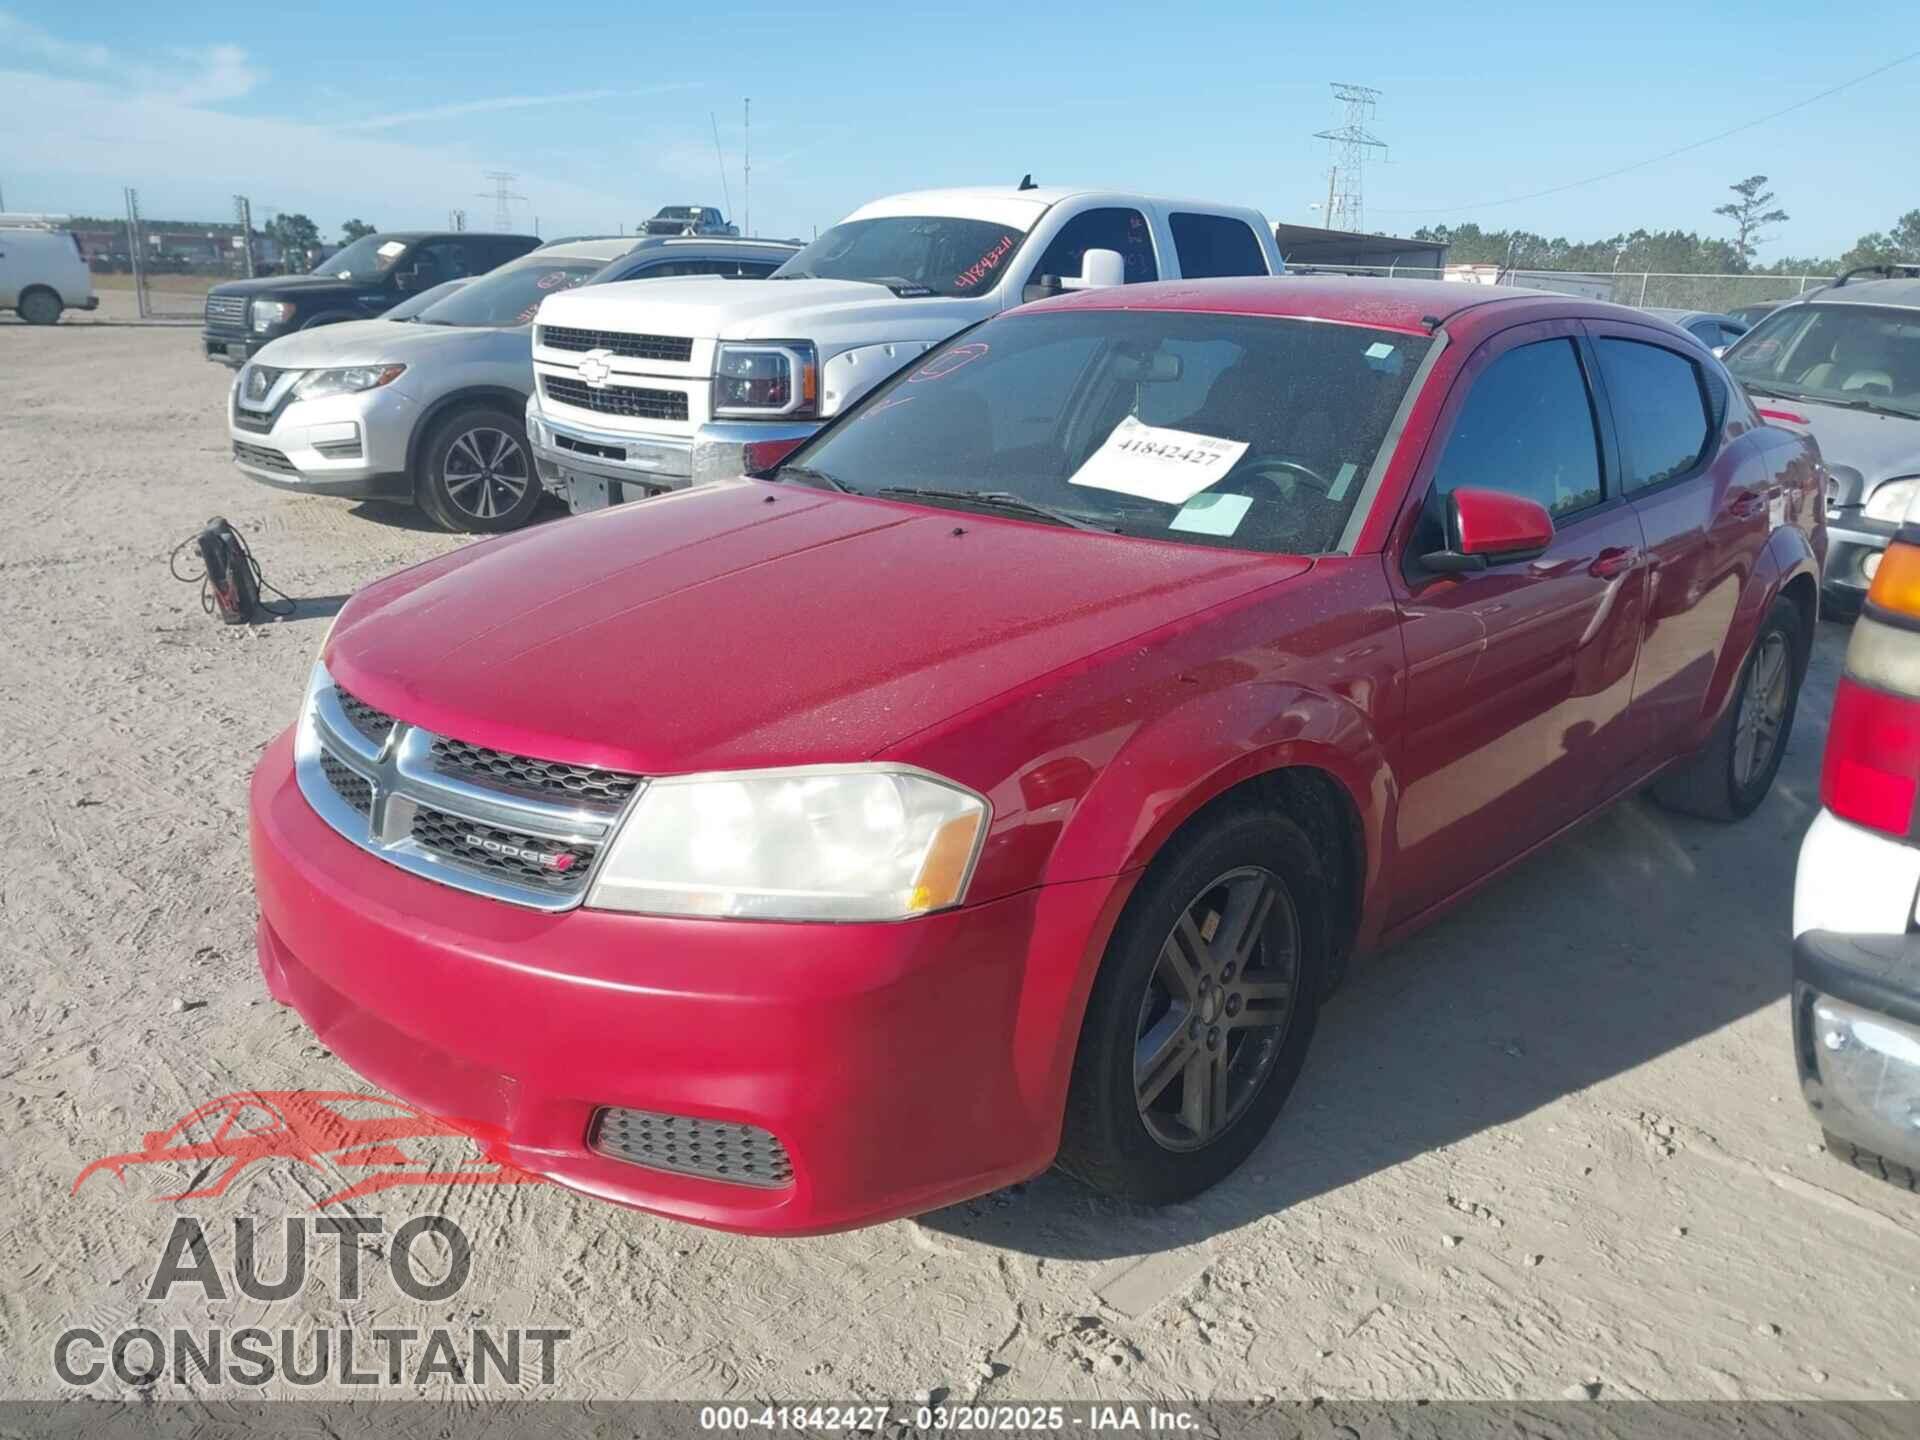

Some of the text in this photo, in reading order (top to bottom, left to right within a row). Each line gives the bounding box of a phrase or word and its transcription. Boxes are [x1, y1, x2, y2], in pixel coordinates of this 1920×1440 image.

[954, 235, 1013, 287] 41843211
[1118, 438, 1222, 466] 41842427
[466, 834, 556, 866] DODGE
